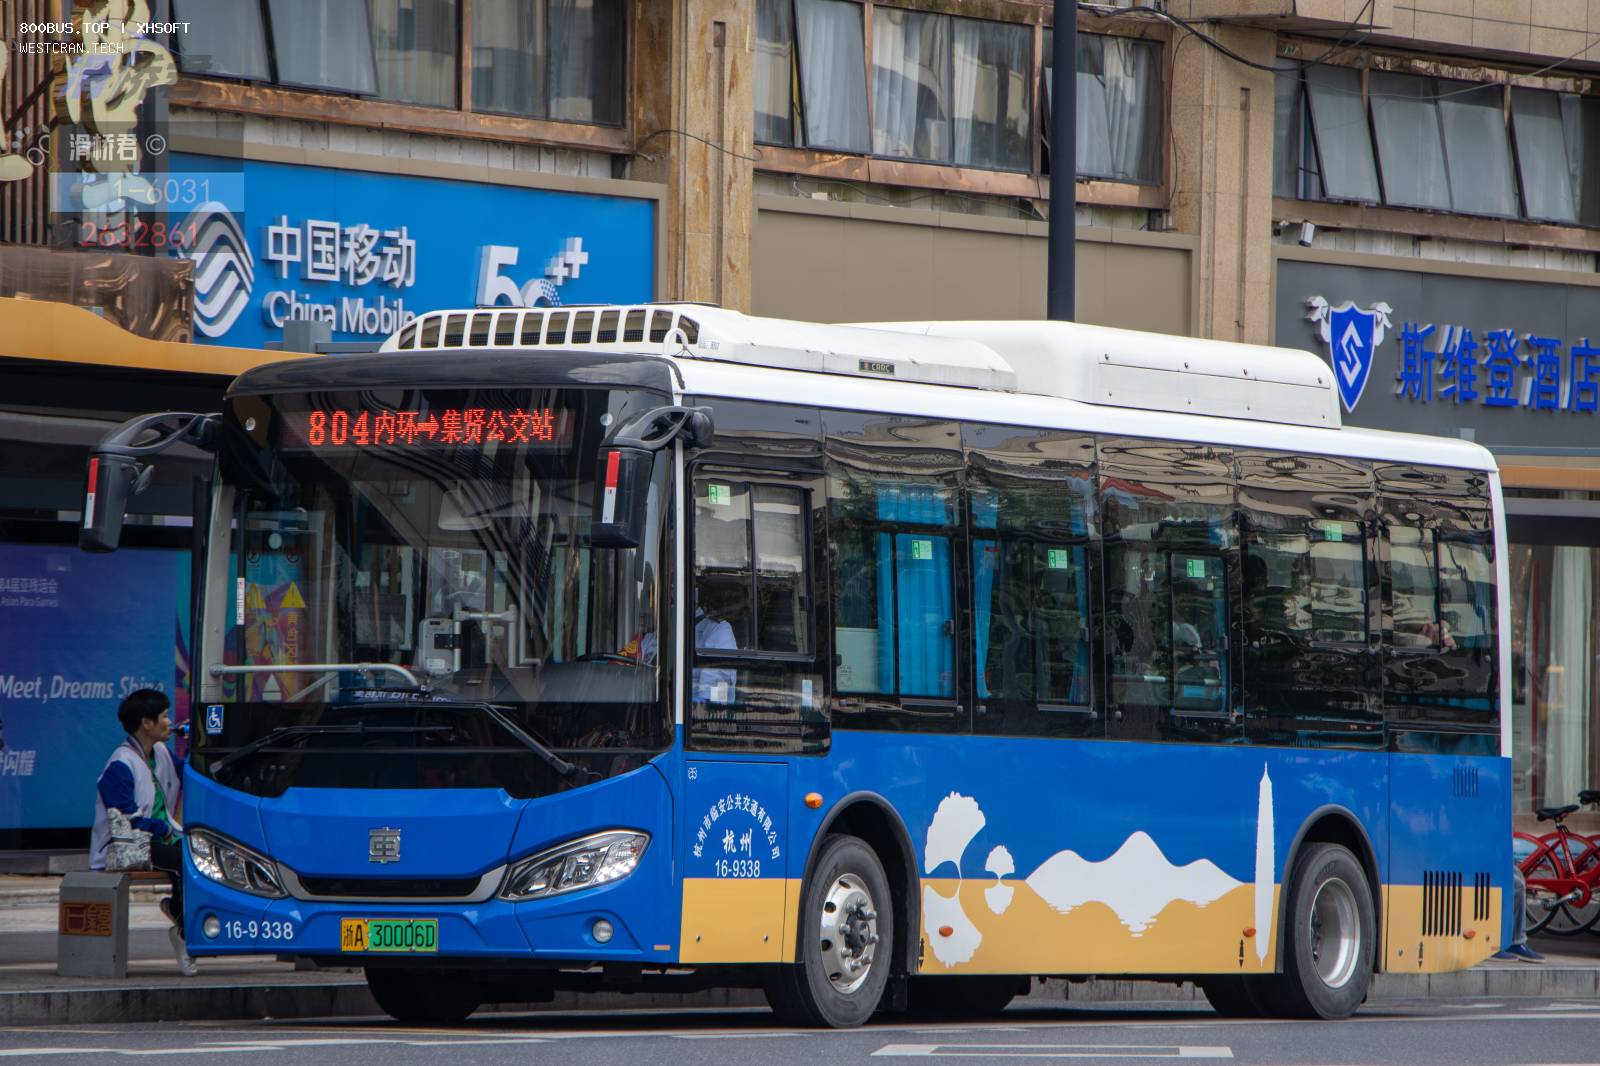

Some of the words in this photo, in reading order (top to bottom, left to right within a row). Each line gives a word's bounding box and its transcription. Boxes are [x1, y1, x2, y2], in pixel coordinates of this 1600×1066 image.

[263, 215, 416, 288] 中国移动
[263, 289, 336, 331] China
[1396, 321, 1600, 413] 斯维登酒店
[308, 410, 369, 446] 804
[440, 408, 554, 444] 集贤公交站
[51, 675, 114, 699] Dreams
[0, 750, 36, 776] 闪耀
[722, 828, 752, 858] 杭州
[715, 859, 760, 877] 16-9338
[224, 920, 294, 939] 16-9338
